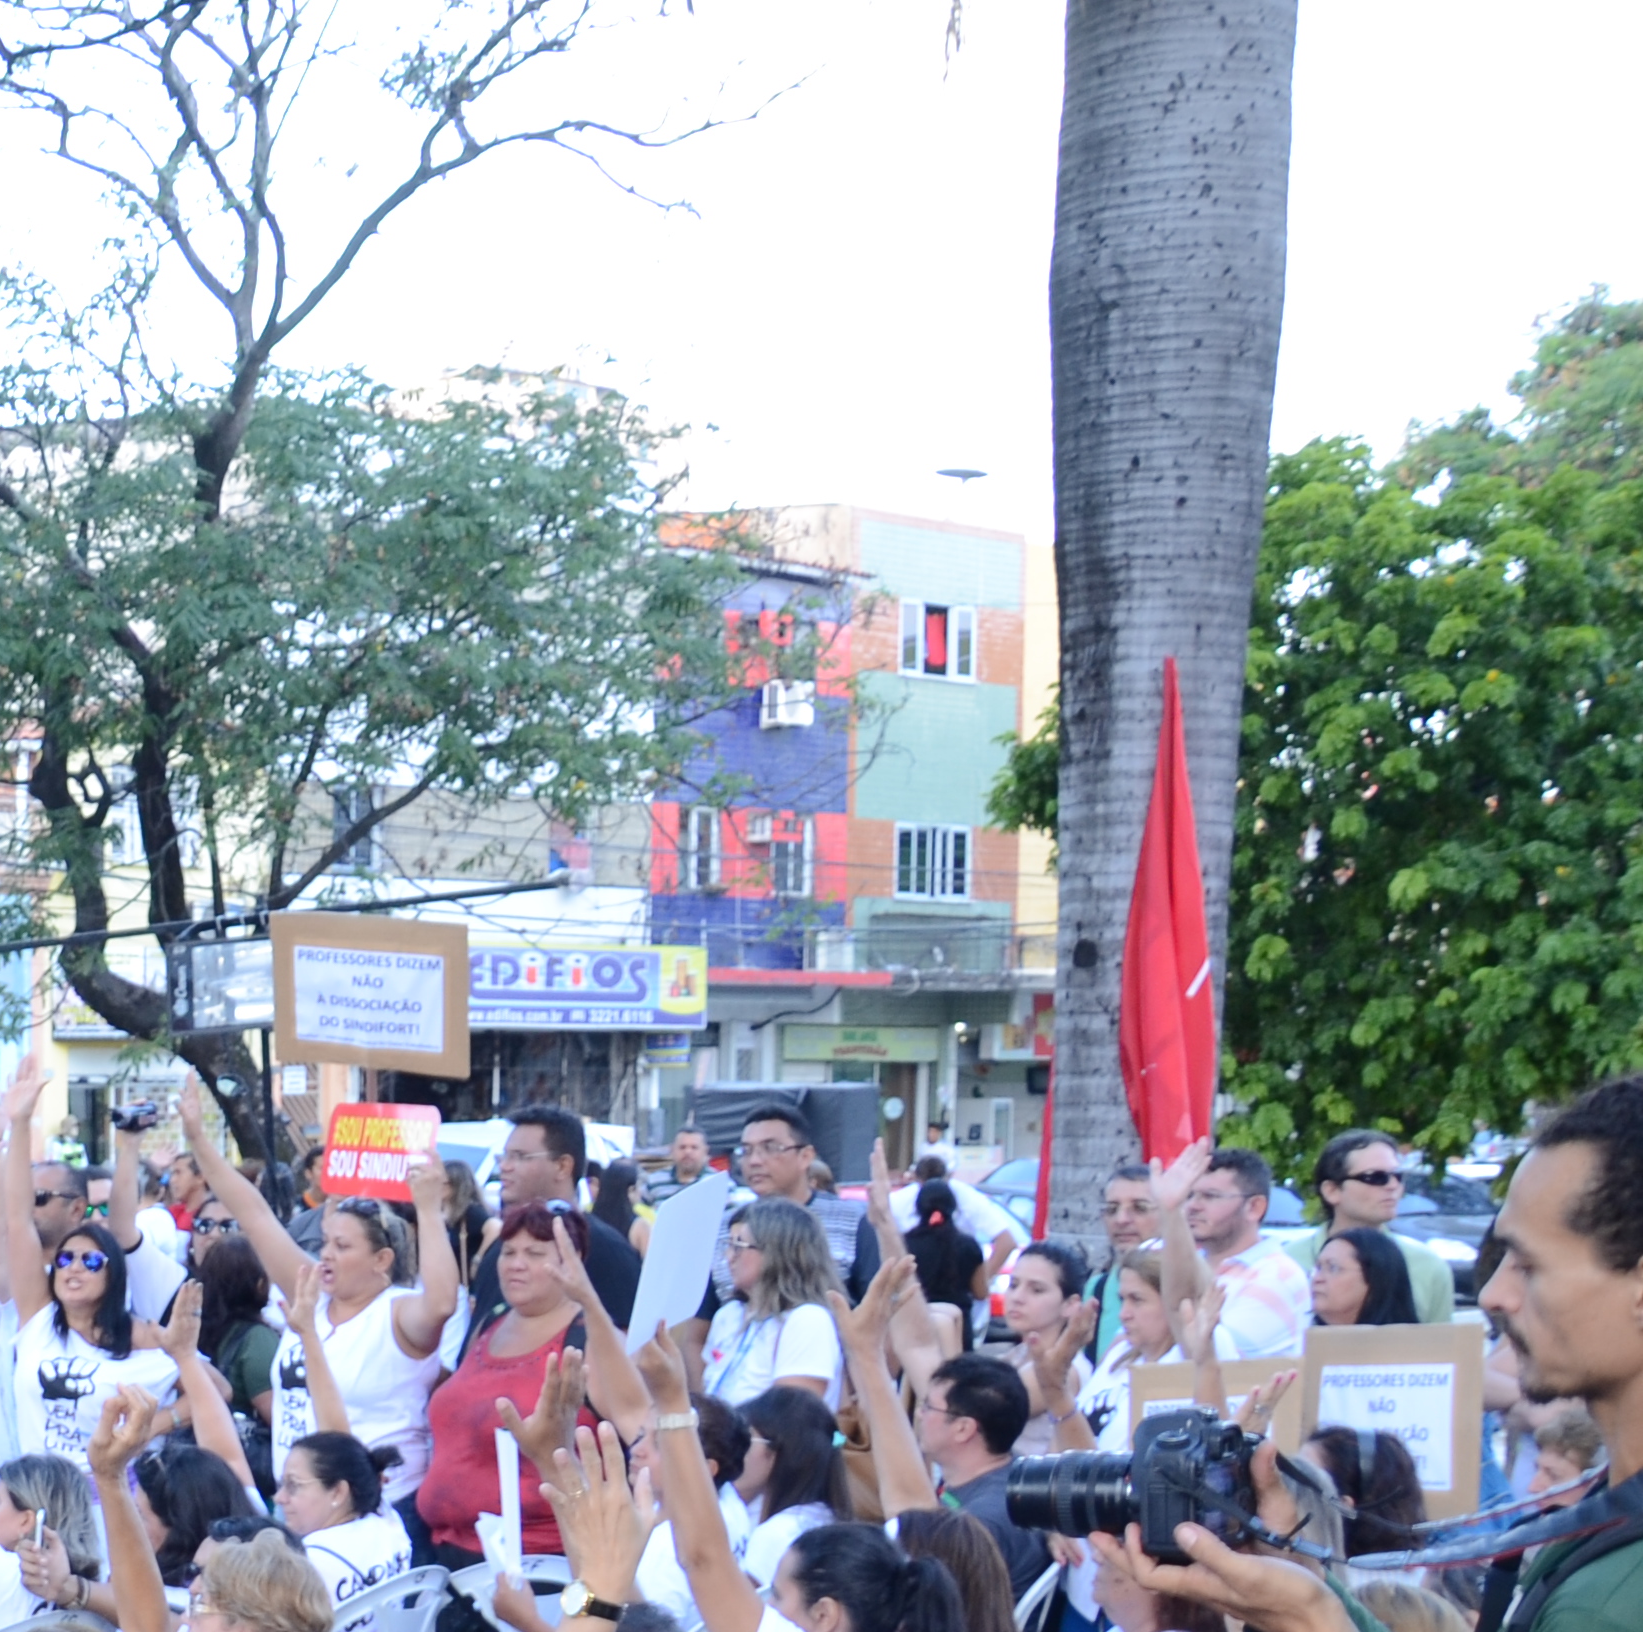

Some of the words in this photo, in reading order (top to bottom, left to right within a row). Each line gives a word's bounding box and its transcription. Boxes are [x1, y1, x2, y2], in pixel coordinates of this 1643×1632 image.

[297, 949, 392, 968] PROFESSORES
[396, 957, 441, 971] DIZEM
[351, 973, 384, 989] NÃO
[330, 994, 423, 1015] DISSOCIAÇÃO
[319, 1015, 340, 1028] DO
[343, 1018, 421, 1035] SINDIFORT!
[327, 1149, 358, 1178] SOU
[1322, 1373, 1409, 1388] PROFESSORES
[1410, 1372, 1449, 1387] DIZEM
[1367, 1394, 1397, 1413] NÃO
